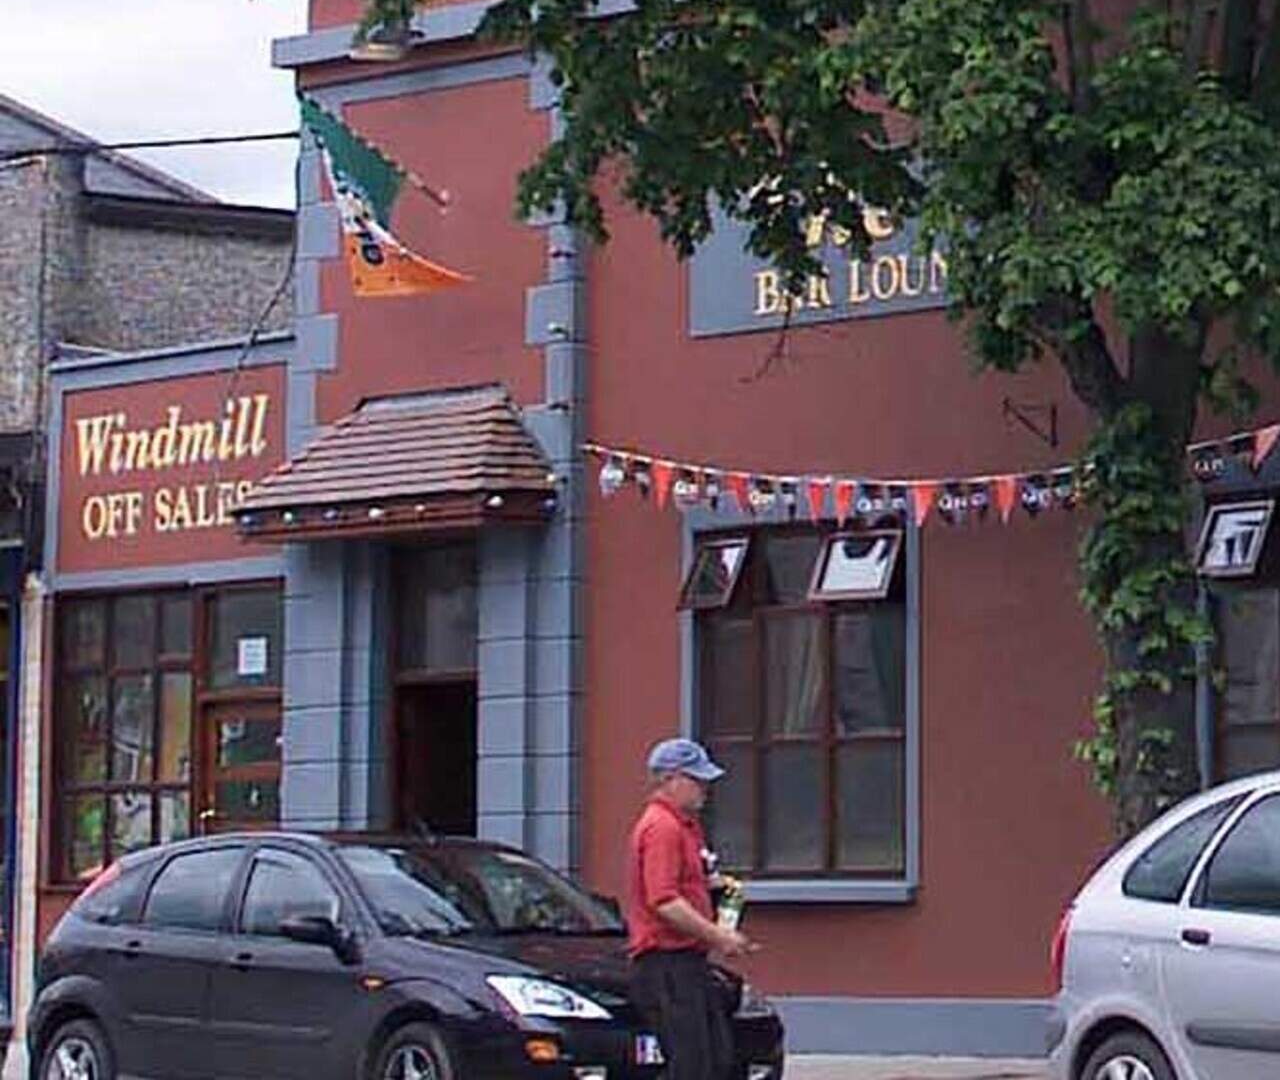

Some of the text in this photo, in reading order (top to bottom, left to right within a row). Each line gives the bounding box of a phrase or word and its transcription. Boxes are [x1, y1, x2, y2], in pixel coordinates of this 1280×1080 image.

[849, 250, 948, 303] LOUN
[76, 394, 269, 476] Windmill
[82, 491, 144, 539] OFF
